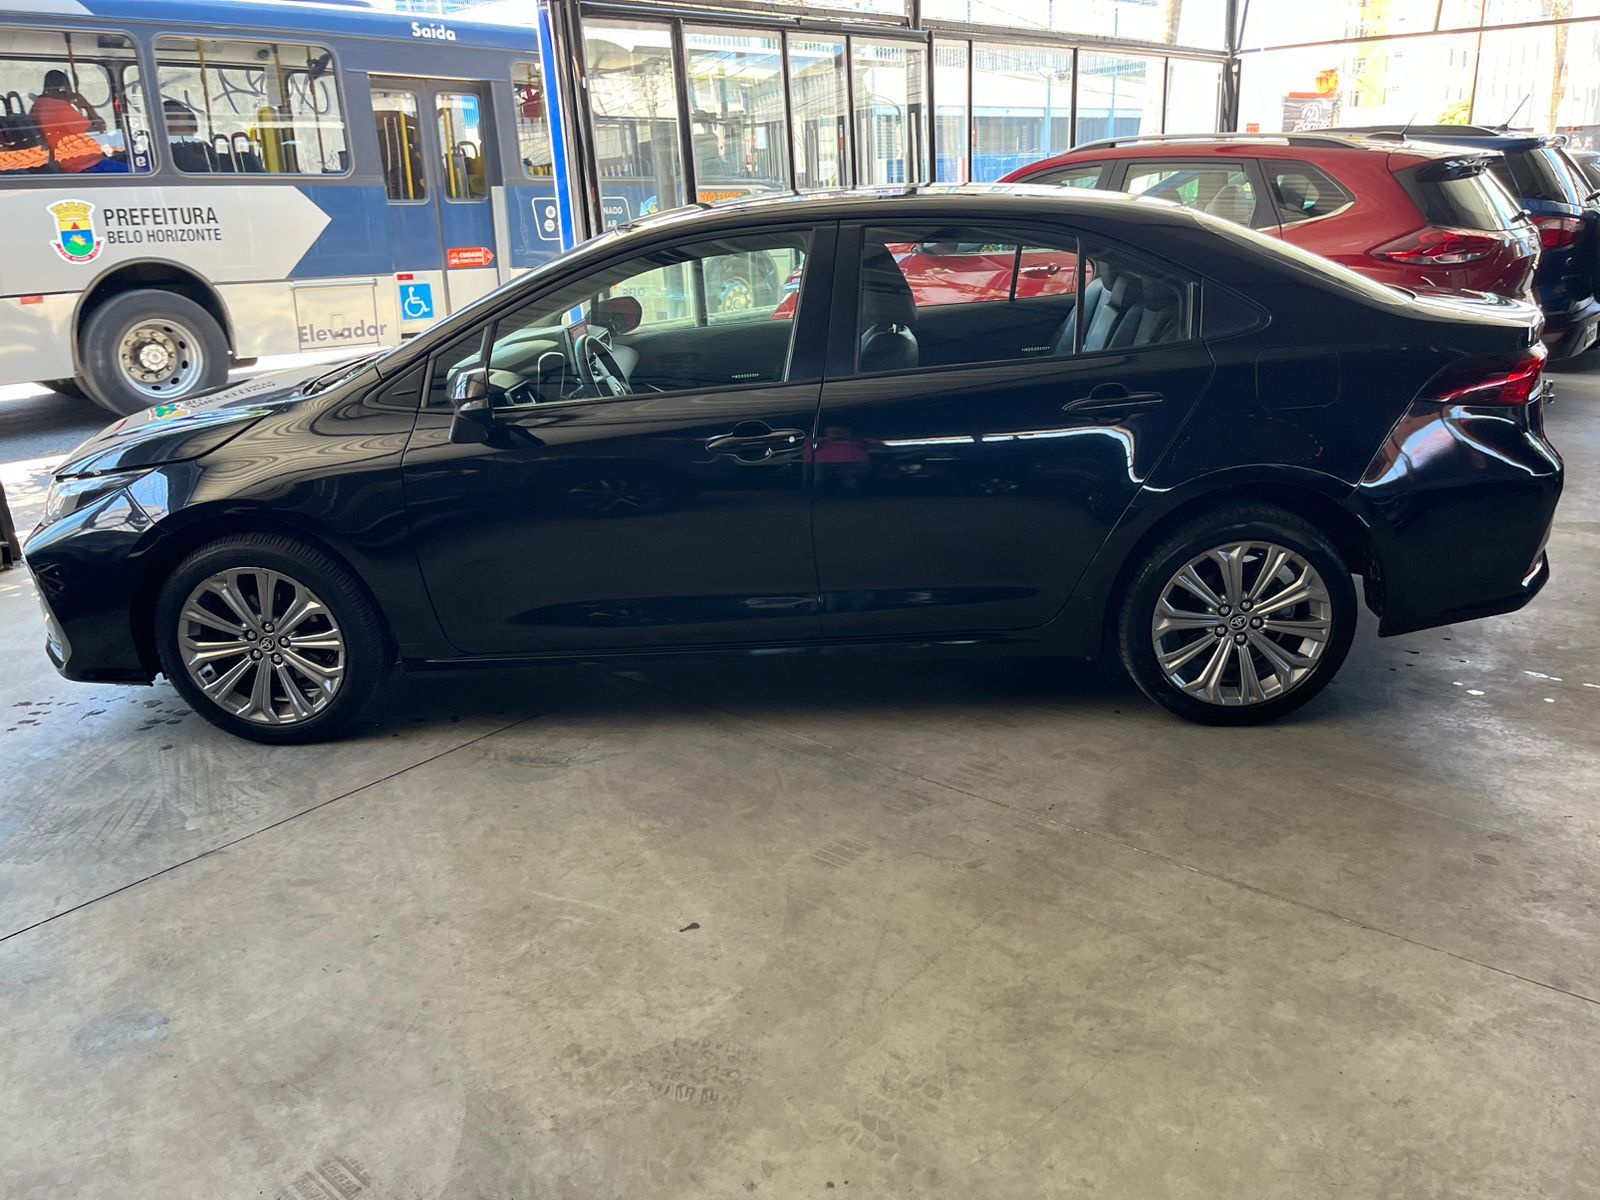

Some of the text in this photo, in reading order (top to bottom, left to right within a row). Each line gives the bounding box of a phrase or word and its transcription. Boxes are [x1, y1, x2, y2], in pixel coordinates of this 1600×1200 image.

[103, 207, 219, 226] PREFEITURA
[107, 228, 222, 244] BELO HORIZONTE
[298, 319, 387, 343] Elevador
